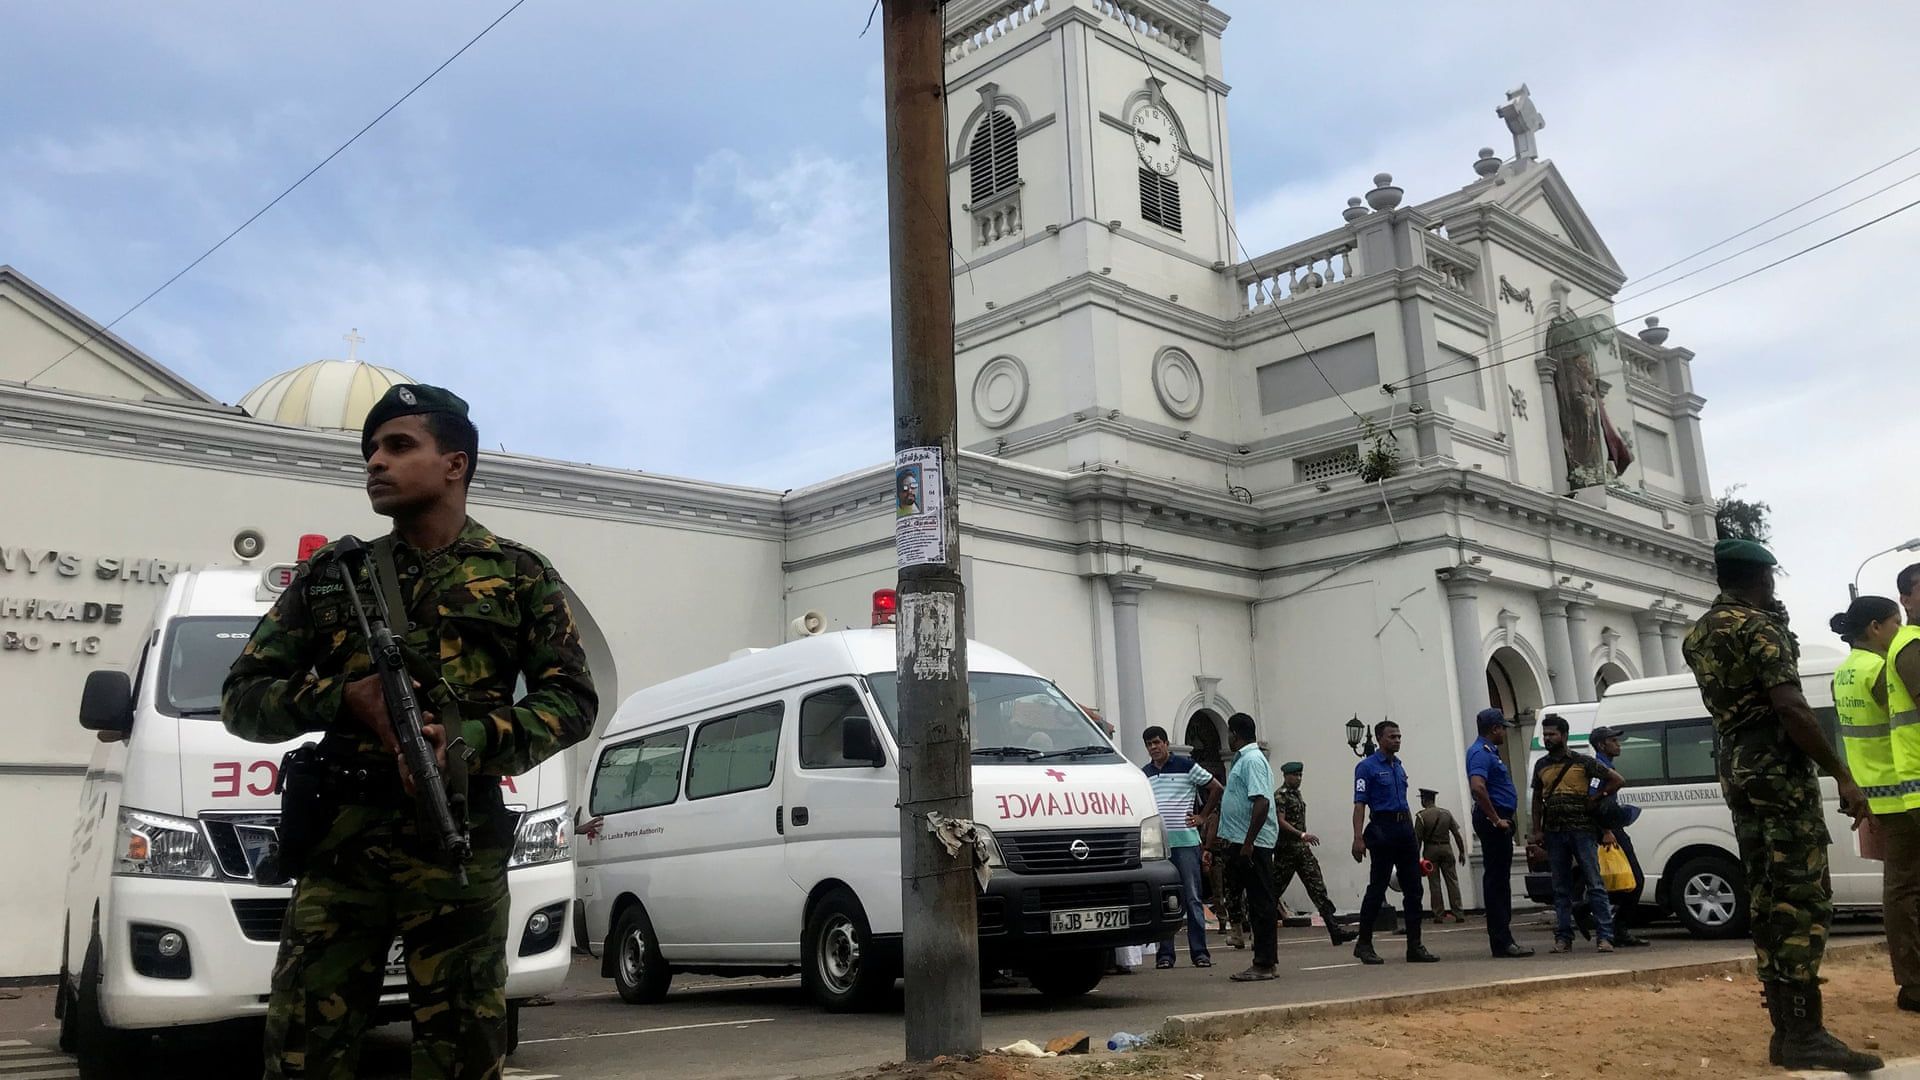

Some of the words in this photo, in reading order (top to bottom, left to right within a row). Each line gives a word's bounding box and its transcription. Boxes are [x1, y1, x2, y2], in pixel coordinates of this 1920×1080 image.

[310, 583, 344, 596] SPECIAL
[1684, 789, 1720, 800] GENERAL
[608, 832, 623, 840] Lanka
[624, 830, 638, 838] Ports
[639, 826, 664, 836] Authority
